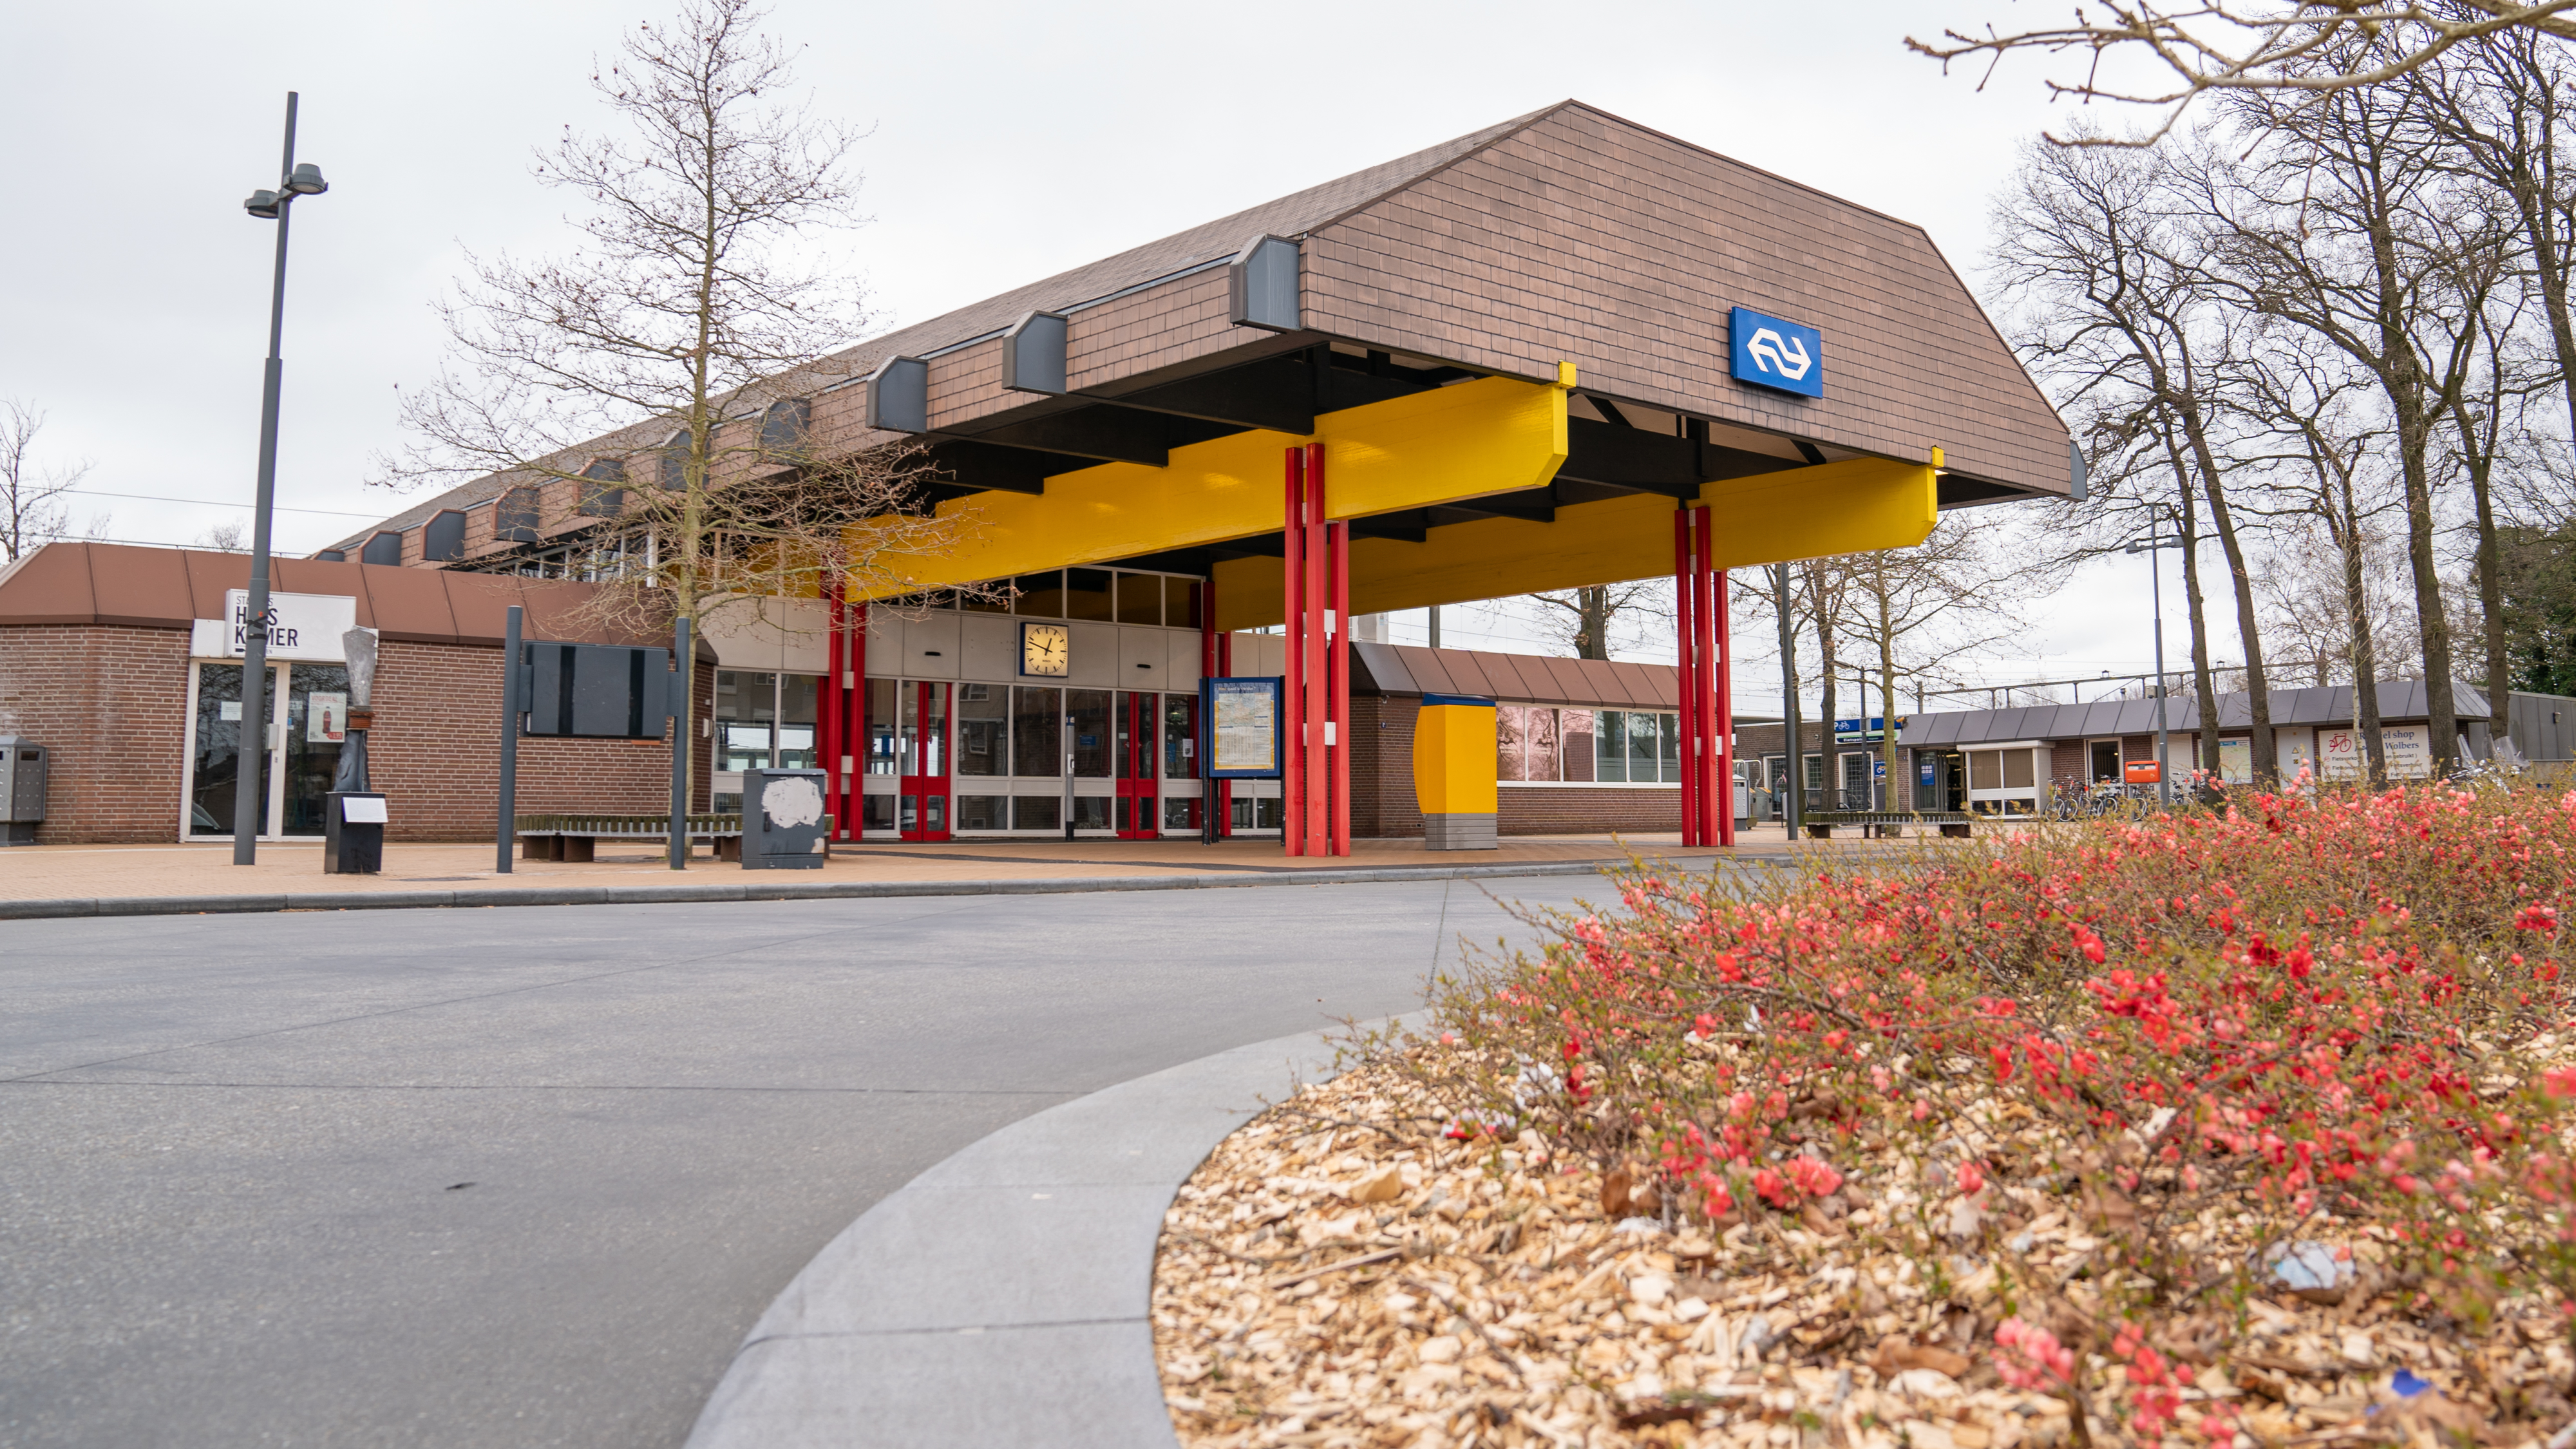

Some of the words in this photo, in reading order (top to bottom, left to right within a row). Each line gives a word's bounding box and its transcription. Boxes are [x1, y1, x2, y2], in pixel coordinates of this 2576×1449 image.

[236, 606, 278, 626] HS
[235, 626, 298, 647] KMER
[2392, 730, 2414, 740] shop
[2385, 741, 2420, 750] Wolbers
